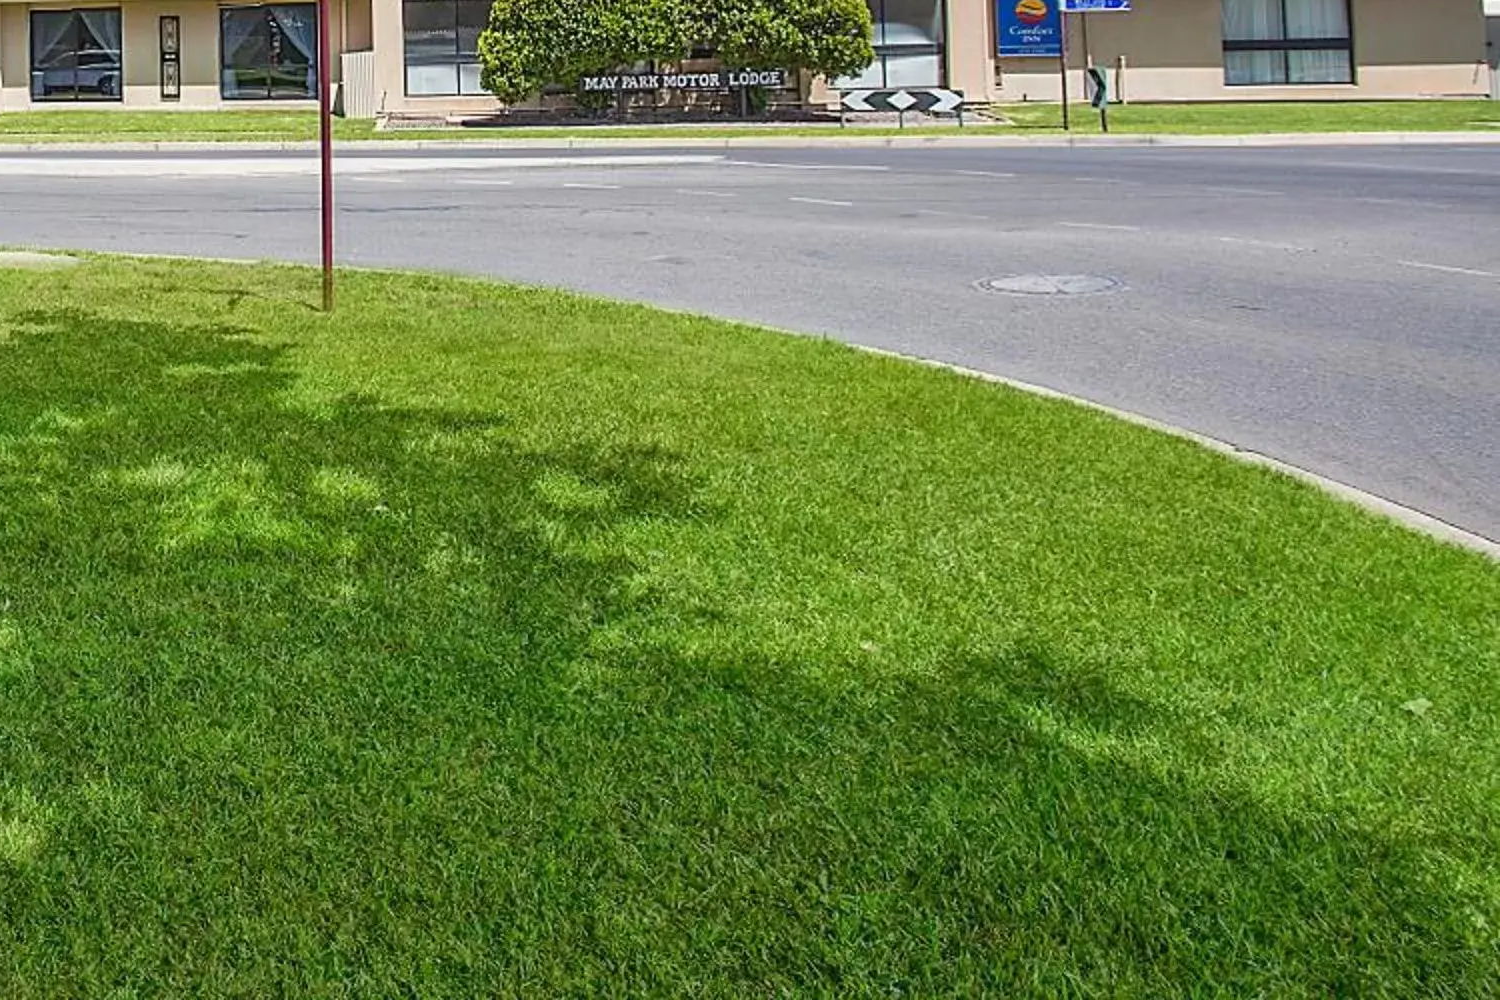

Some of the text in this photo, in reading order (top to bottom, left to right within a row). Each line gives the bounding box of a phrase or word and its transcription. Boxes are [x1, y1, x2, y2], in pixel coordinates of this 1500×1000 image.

[583, 71, 781, 91] MAY PARK MOTOR LODGE
